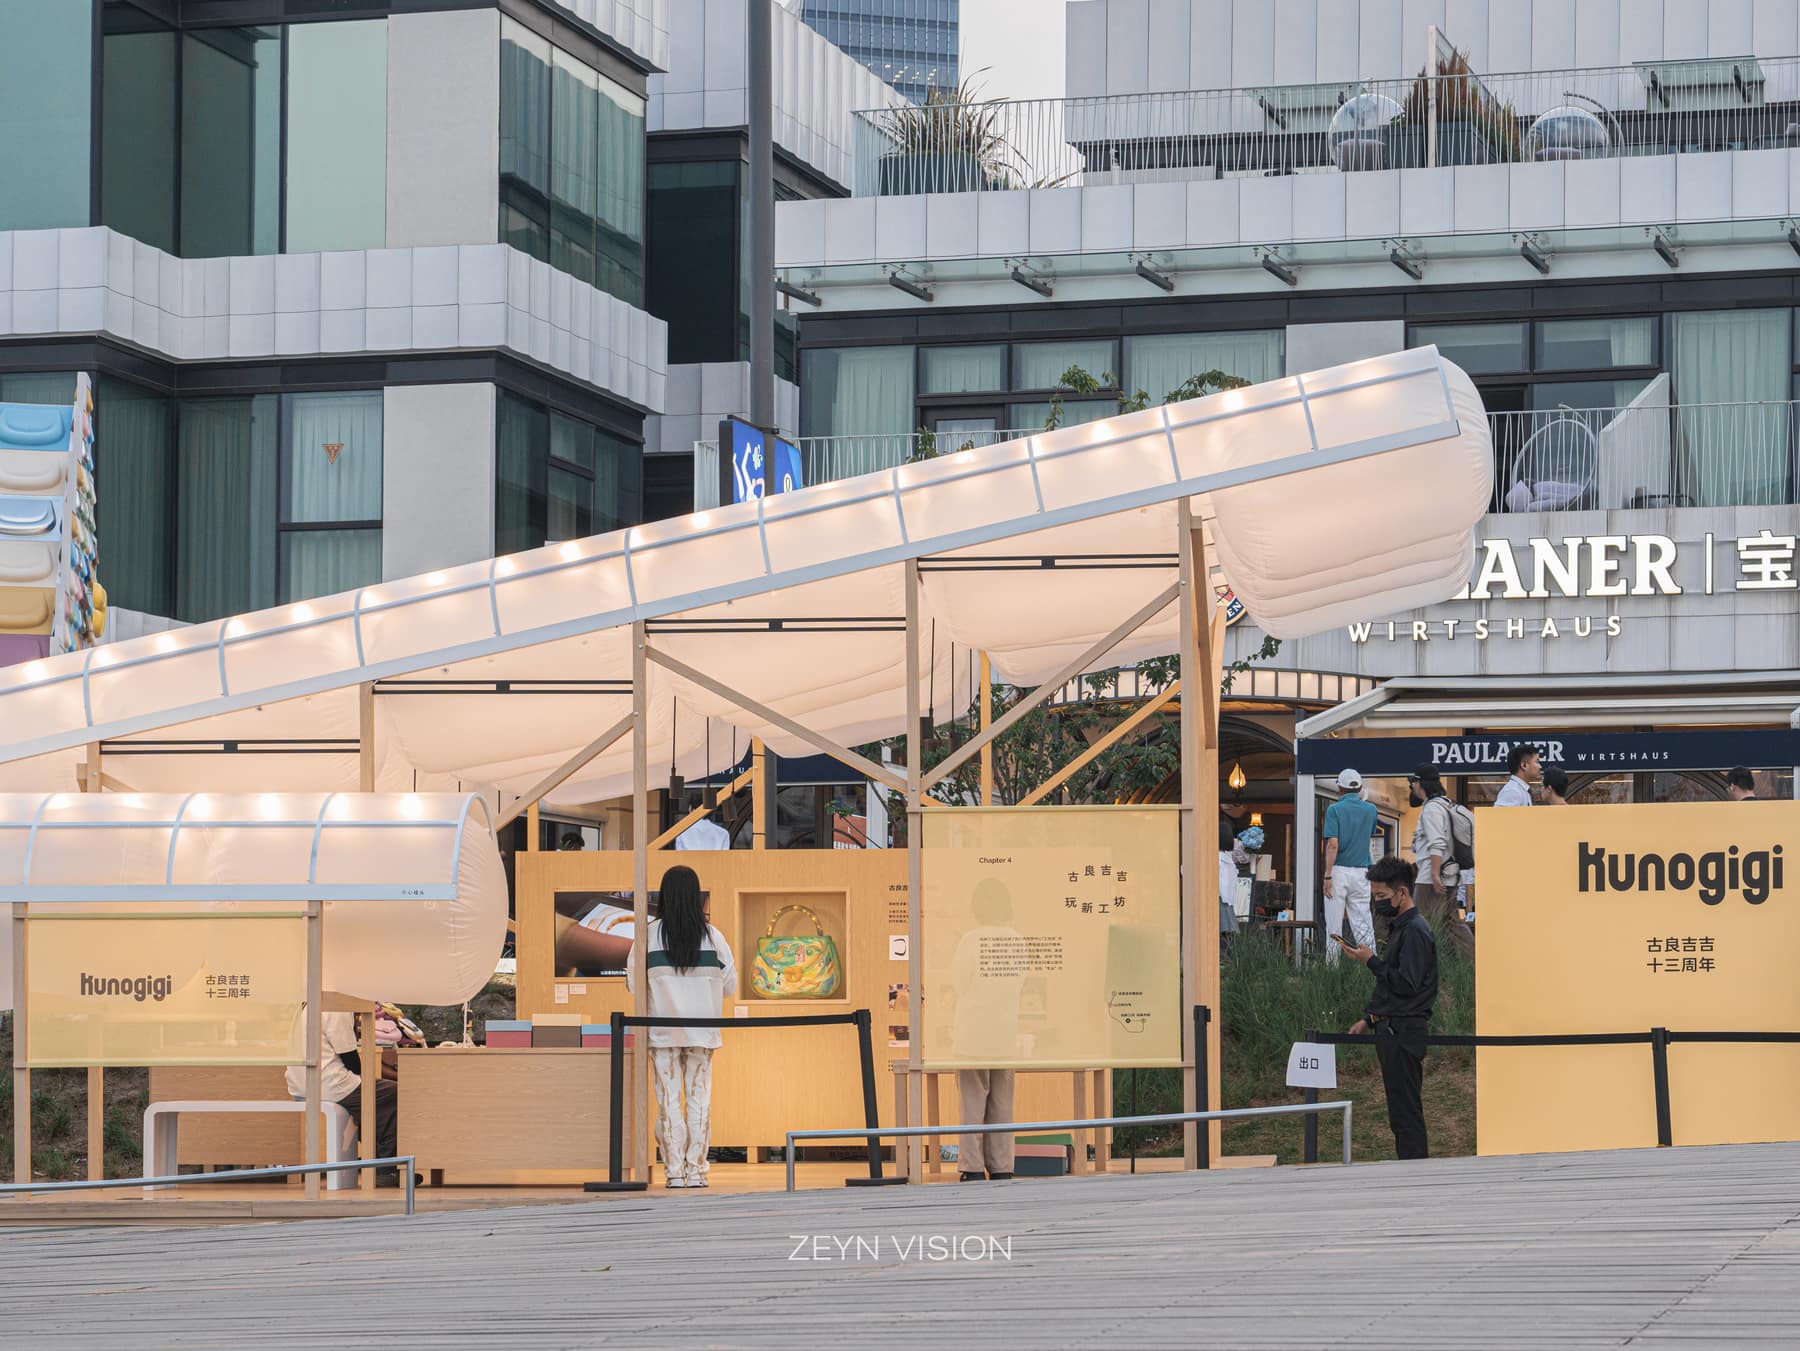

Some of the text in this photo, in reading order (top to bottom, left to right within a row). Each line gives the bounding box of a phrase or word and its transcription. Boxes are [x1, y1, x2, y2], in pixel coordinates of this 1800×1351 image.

[1449, 534, 1684, 601] ANER
[1736, 529, 1798, 590] 宝
[1347, 614, 1622, 644] WIRTSHAUS
[1577, 751, 1670, 762] WIRTSHAUS
[1067, 865, 1128, 882] 古良吉吉
[1065, 896, 1126, 914] 玩新工坊
[1646, 936, 1716, 953] 古良吉吉
[1646, 956, 1716, 973] 十三周年
[205, 975, 251, 986] 古良吉吉
[205, 988, 251, 999] 十三周年
[1299, 1056, 1319, 1070] 出口
